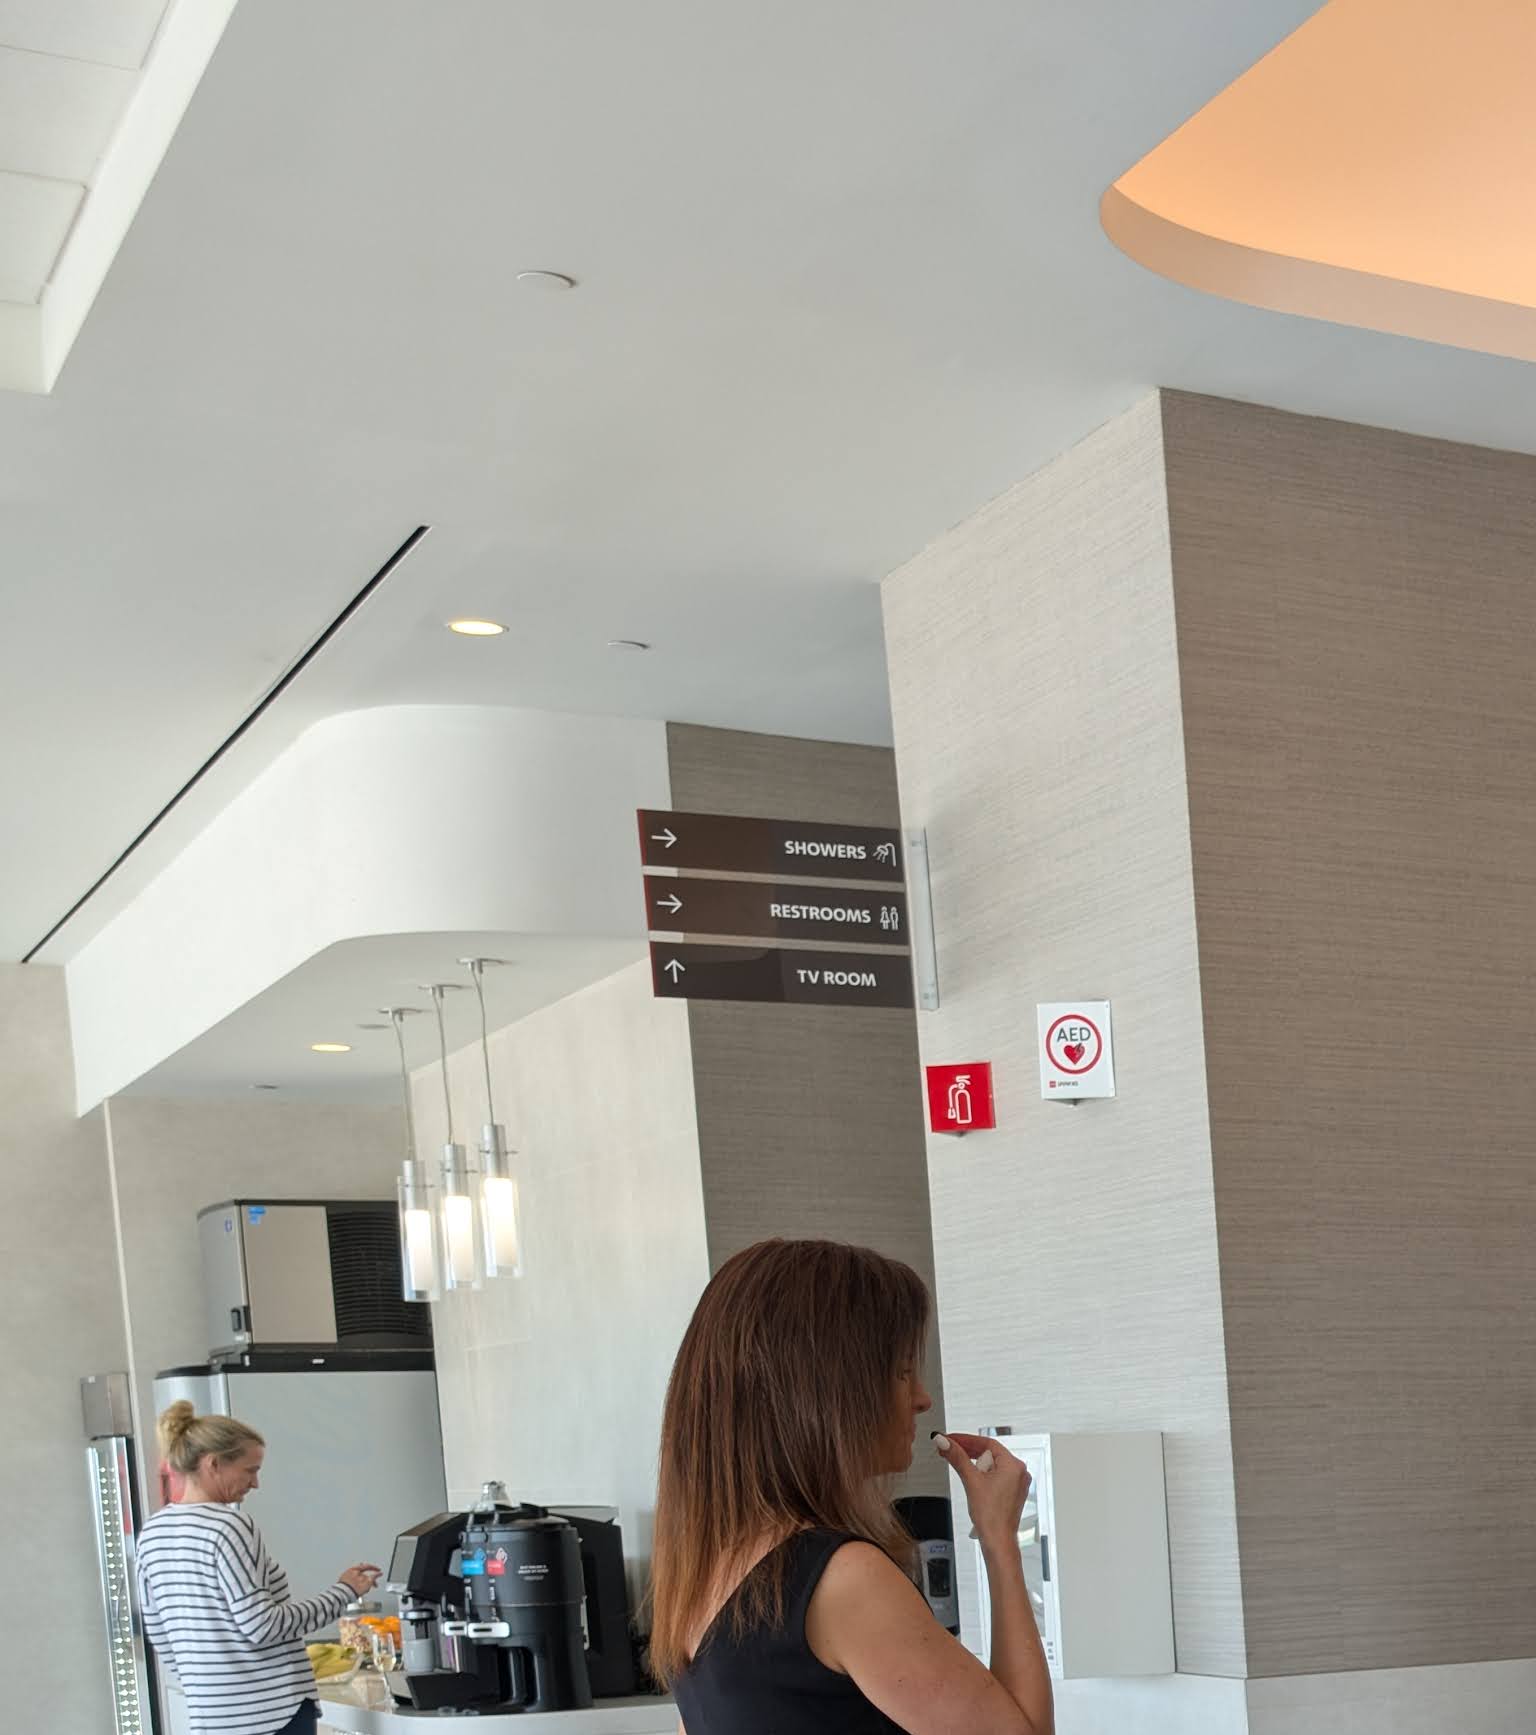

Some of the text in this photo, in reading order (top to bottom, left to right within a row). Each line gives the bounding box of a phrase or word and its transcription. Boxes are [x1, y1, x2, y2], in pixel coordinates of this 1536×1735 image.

[784, 840, 867, 860] SHOWERS
[770, 903, 872, 924] RESTROOMS
[797, 969, 877, 987] TV ROOM
[1056, 1027, 1091, 1043] AED
